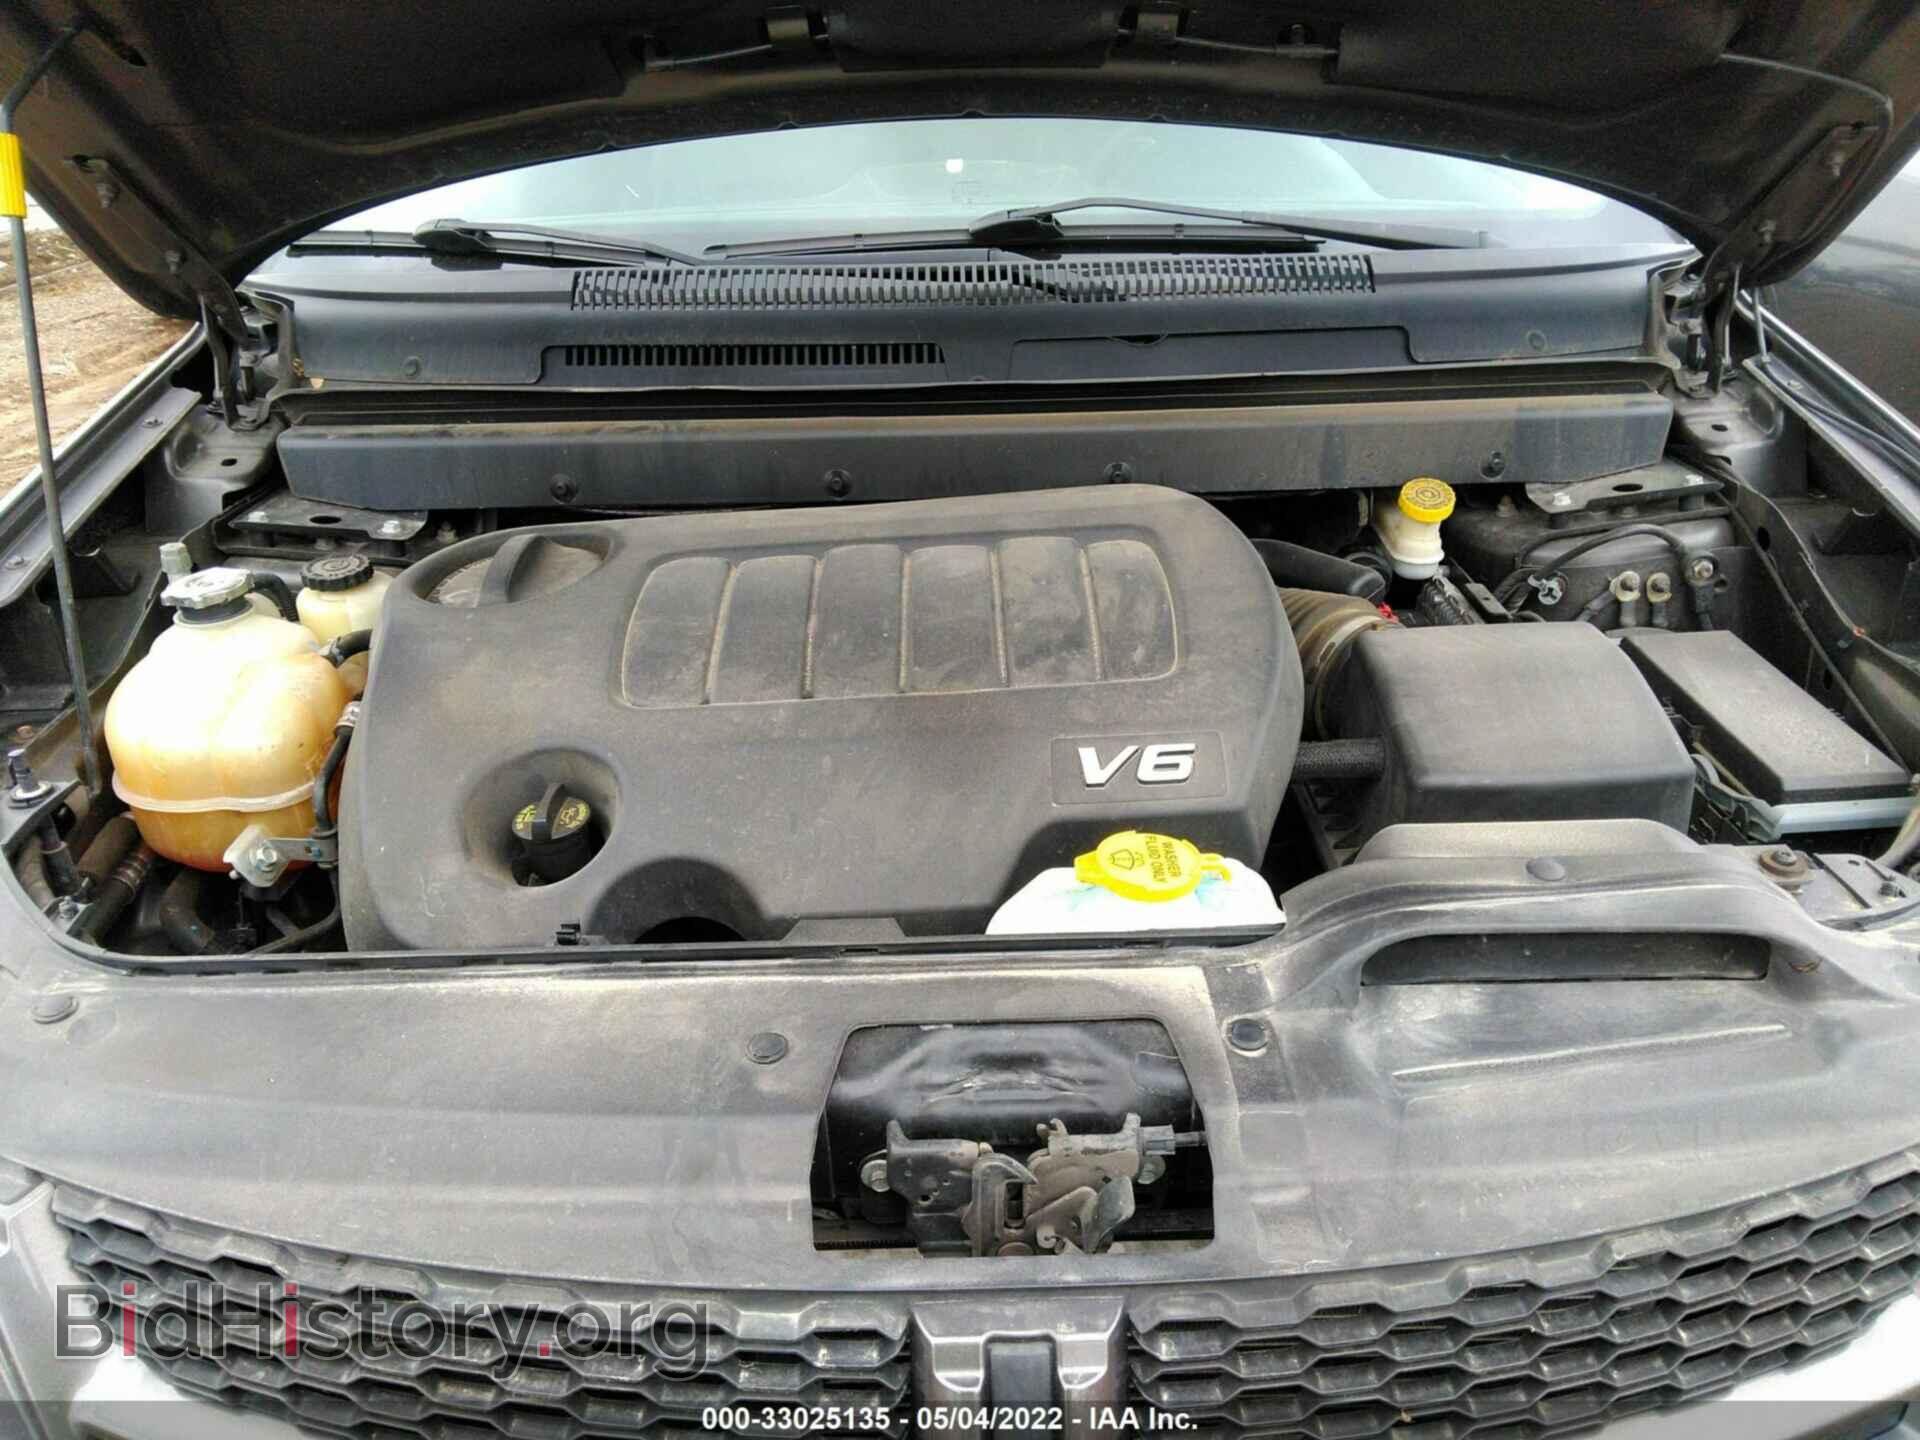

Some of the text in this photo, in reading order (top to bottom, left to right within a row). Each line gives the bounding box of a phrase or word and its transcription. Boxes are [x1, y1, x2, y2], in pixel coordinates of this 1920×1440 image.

[1078, 743, 1196, 787] V6
[1144, 835, 1168, 883] FLUID ONLY
[1161, 841, 1182, 877] WASHER
